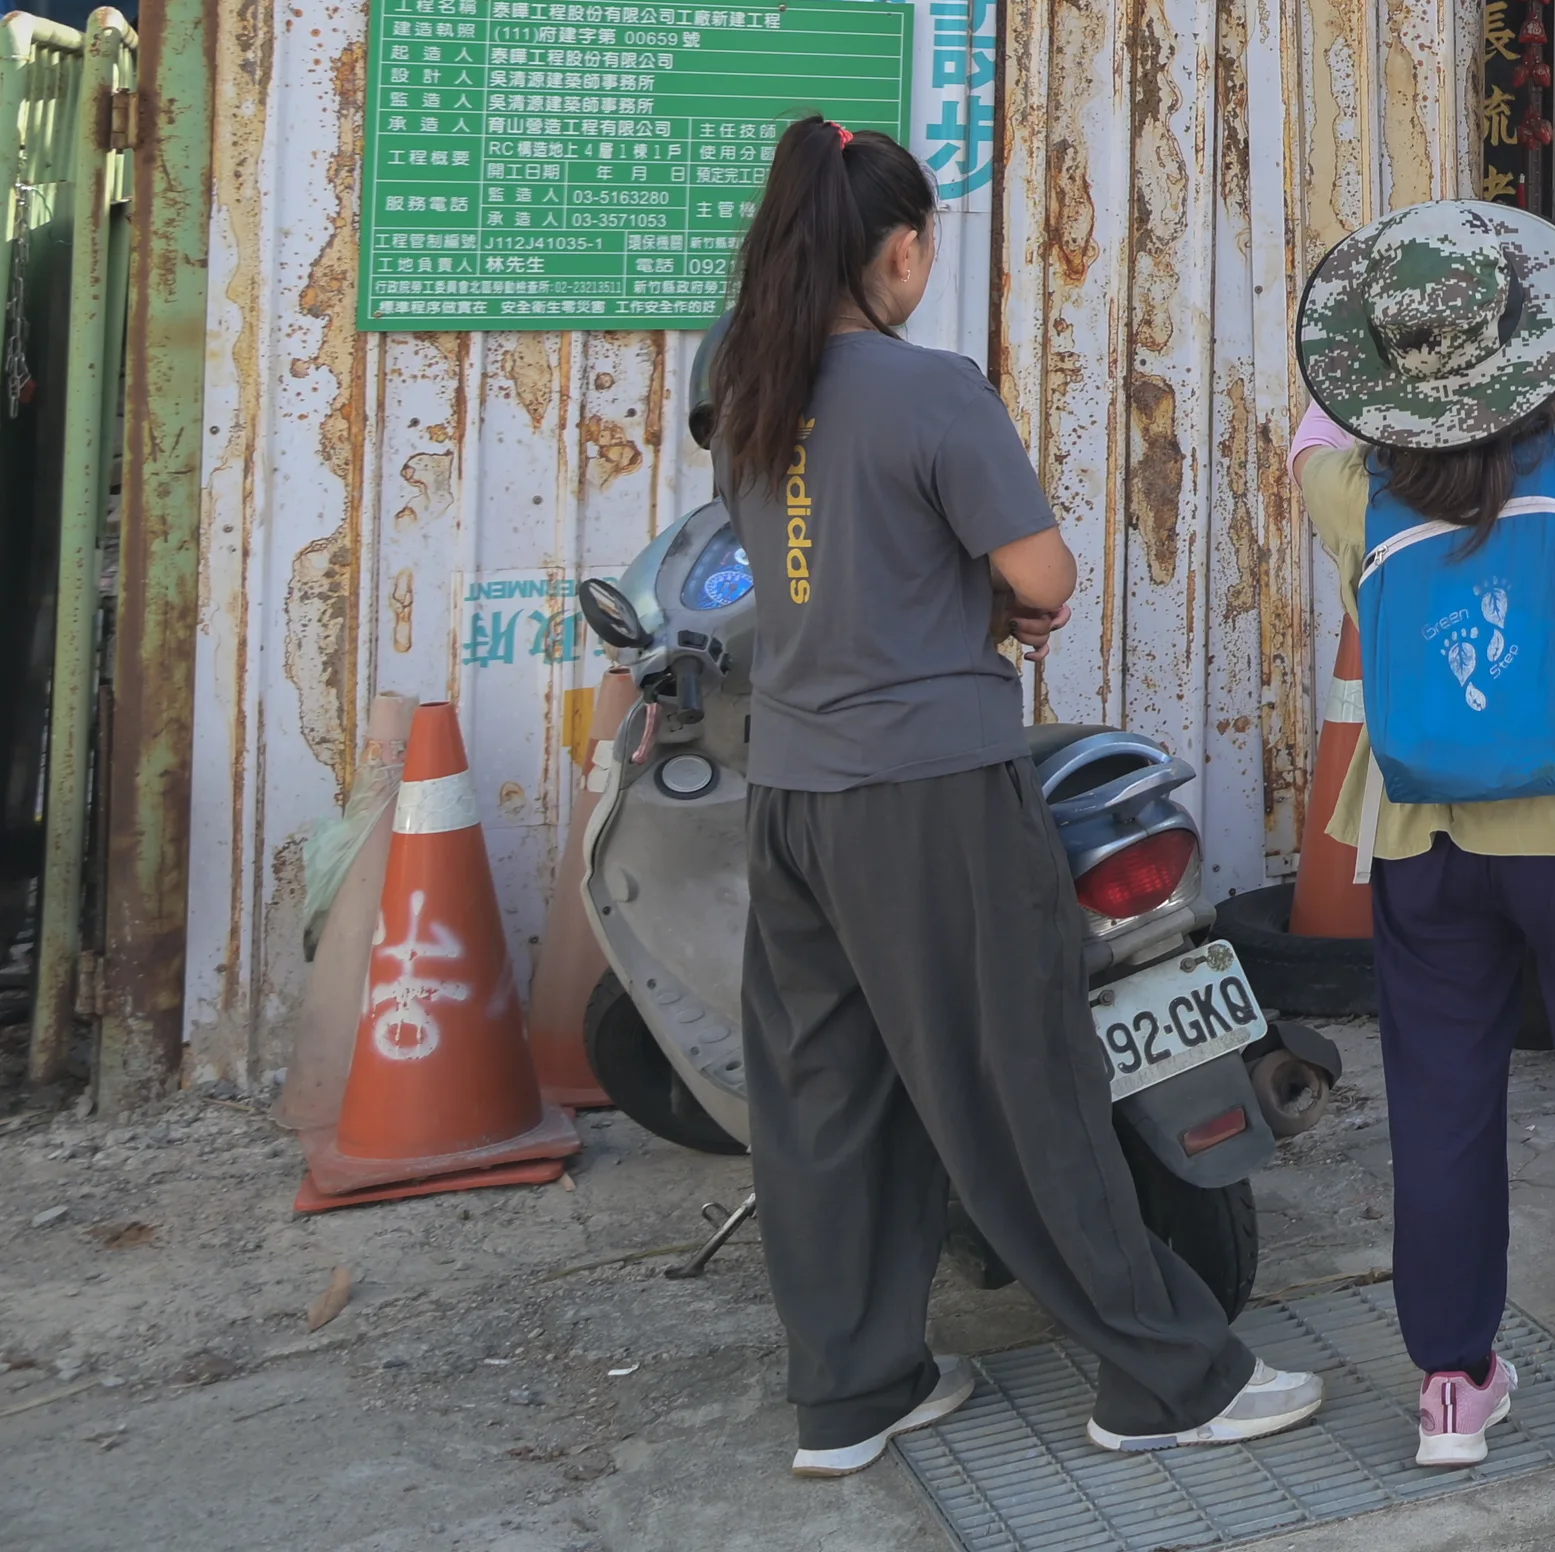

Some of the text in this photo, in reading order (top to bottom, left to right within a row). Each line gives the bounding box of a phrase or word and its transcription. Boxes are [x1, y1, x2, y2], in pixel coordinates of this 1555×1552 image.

[393, 21, 475, 38] 建造執照
[390, 45, 473, 62] 起造人
[391, 68, 655, 91] 設計人 吳清源建築師事務所
[390, 92, 654, 114] 監造人 吳清源建築師事務所
[387, 116, 470, 132] 承造人
[701, 123, 776, 138] 主任技師
[388, 150, 470, 166] 工程概要
[486, 163, 560, 179] 開工日期
[697, 167, 770, 184] 預定完工日
[385, 196, 468, 212] 服務電話
[488, 188, 669, 204] 監造人 03-5163280
[487, 211, 667, 228] 承造人 03-3571053
[375, 234, 477, 249] 工程管制編號
[485, 237, 602, 250] J112J41035-1
[378, 258, 473, 272] 工地負責人
[485, 256, 545, 273] 林先生
[636, 258, 674, 273] 電話
[787, 445, 812, 604] adidas
[1422, 608, 1469, 641] Green
[1490, 644, 1518, 679] Step
